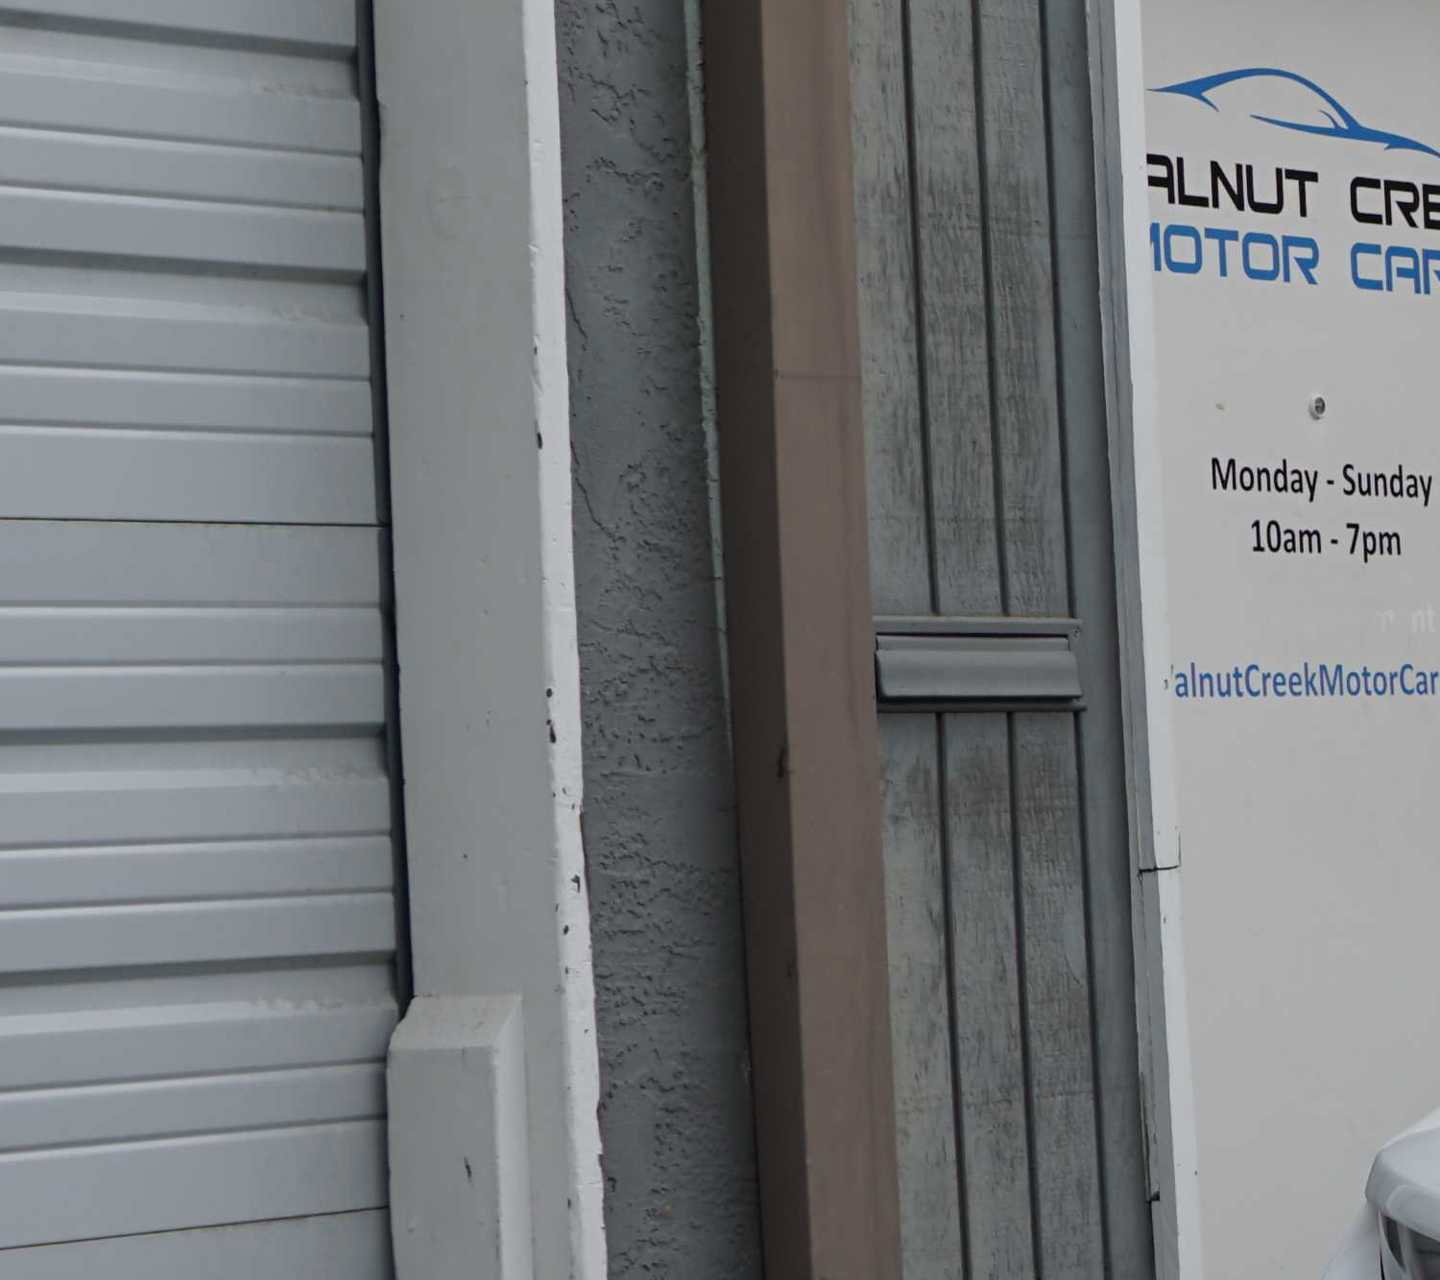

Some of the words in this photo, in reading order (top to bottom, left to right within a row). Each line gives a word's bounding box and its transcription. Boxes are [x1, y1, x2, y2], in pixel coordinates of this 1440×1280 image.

[1211, 457, 1319, 503] Monday
[1342, 463, 1433, 508] Sunday
[1251, 519, 1322, 555] 10am
[1345, 522, 1402, 564] 7pm
